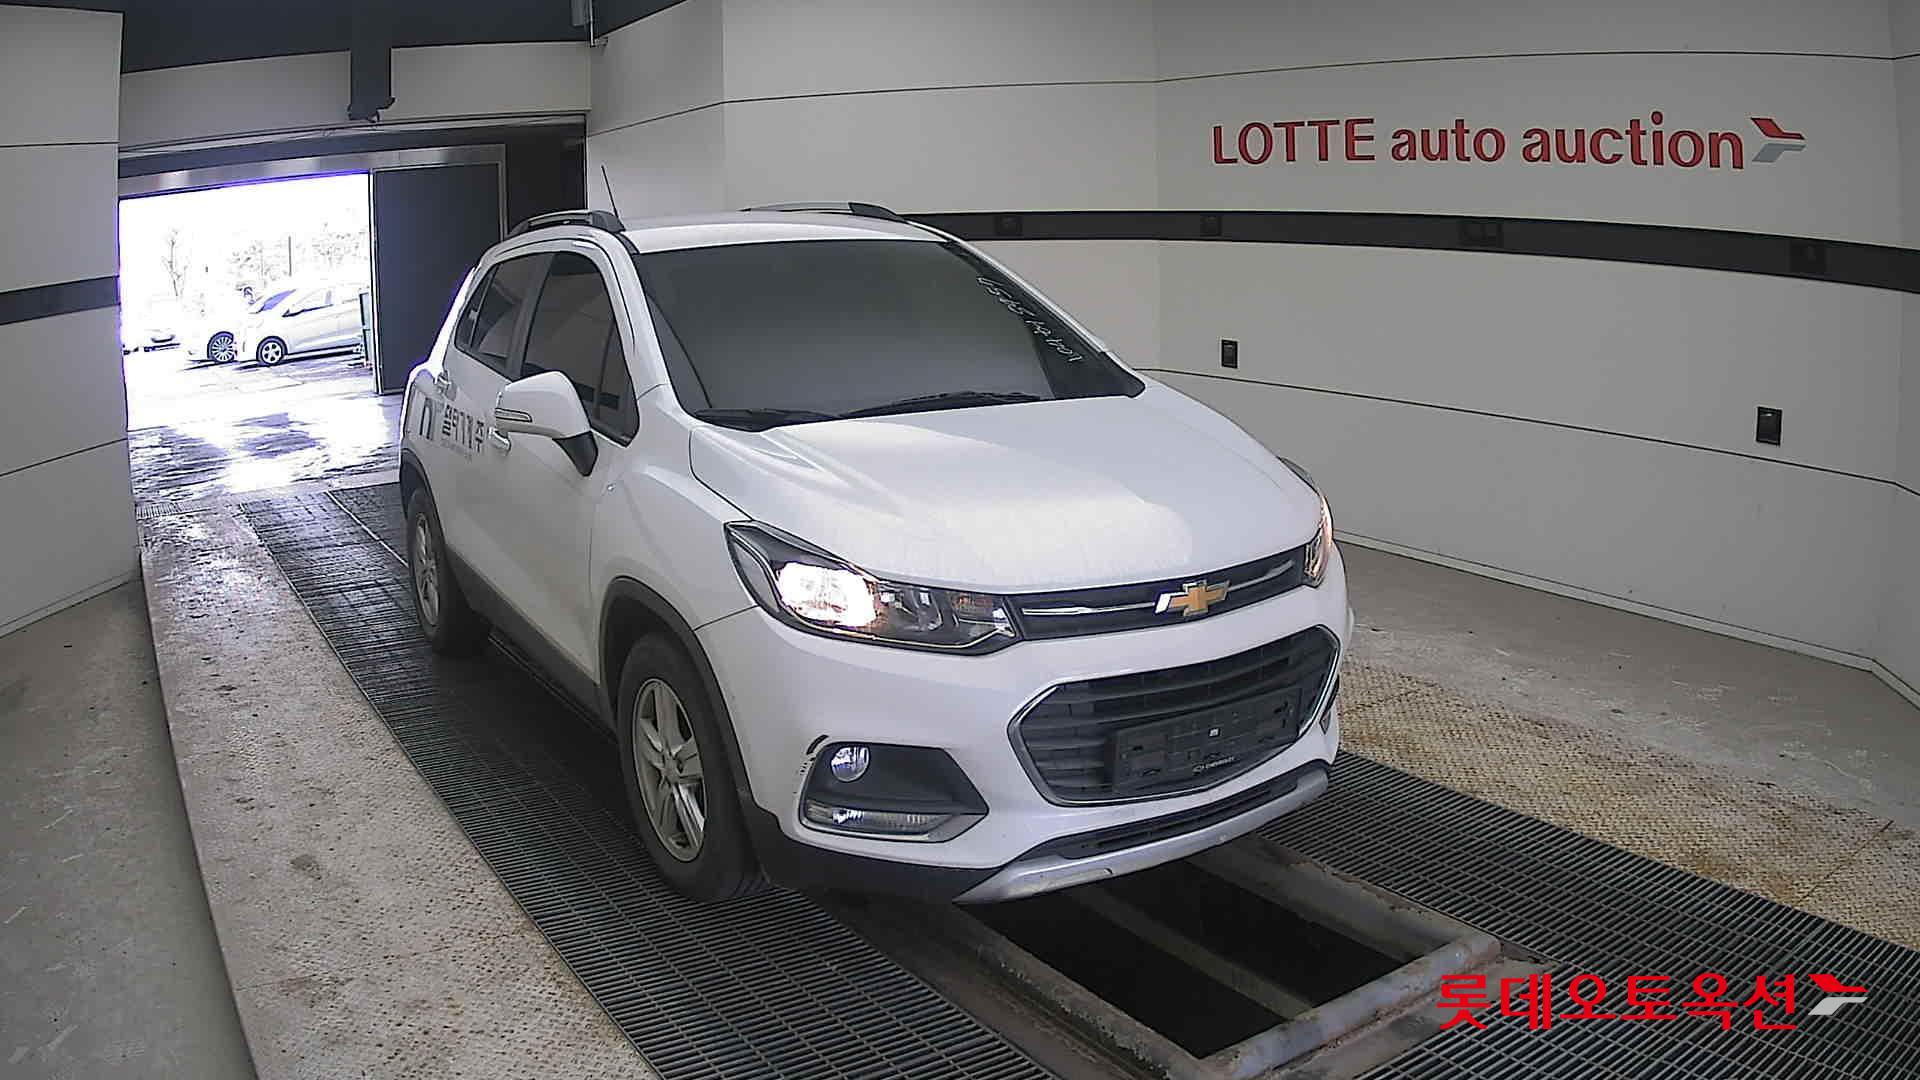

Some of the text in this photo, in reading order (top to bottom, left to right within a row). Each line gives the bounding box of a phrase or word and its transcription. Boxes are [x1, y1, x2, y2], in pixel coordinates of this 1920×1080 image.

[1213, 111, 1745, 170] LOTTE auto auction
